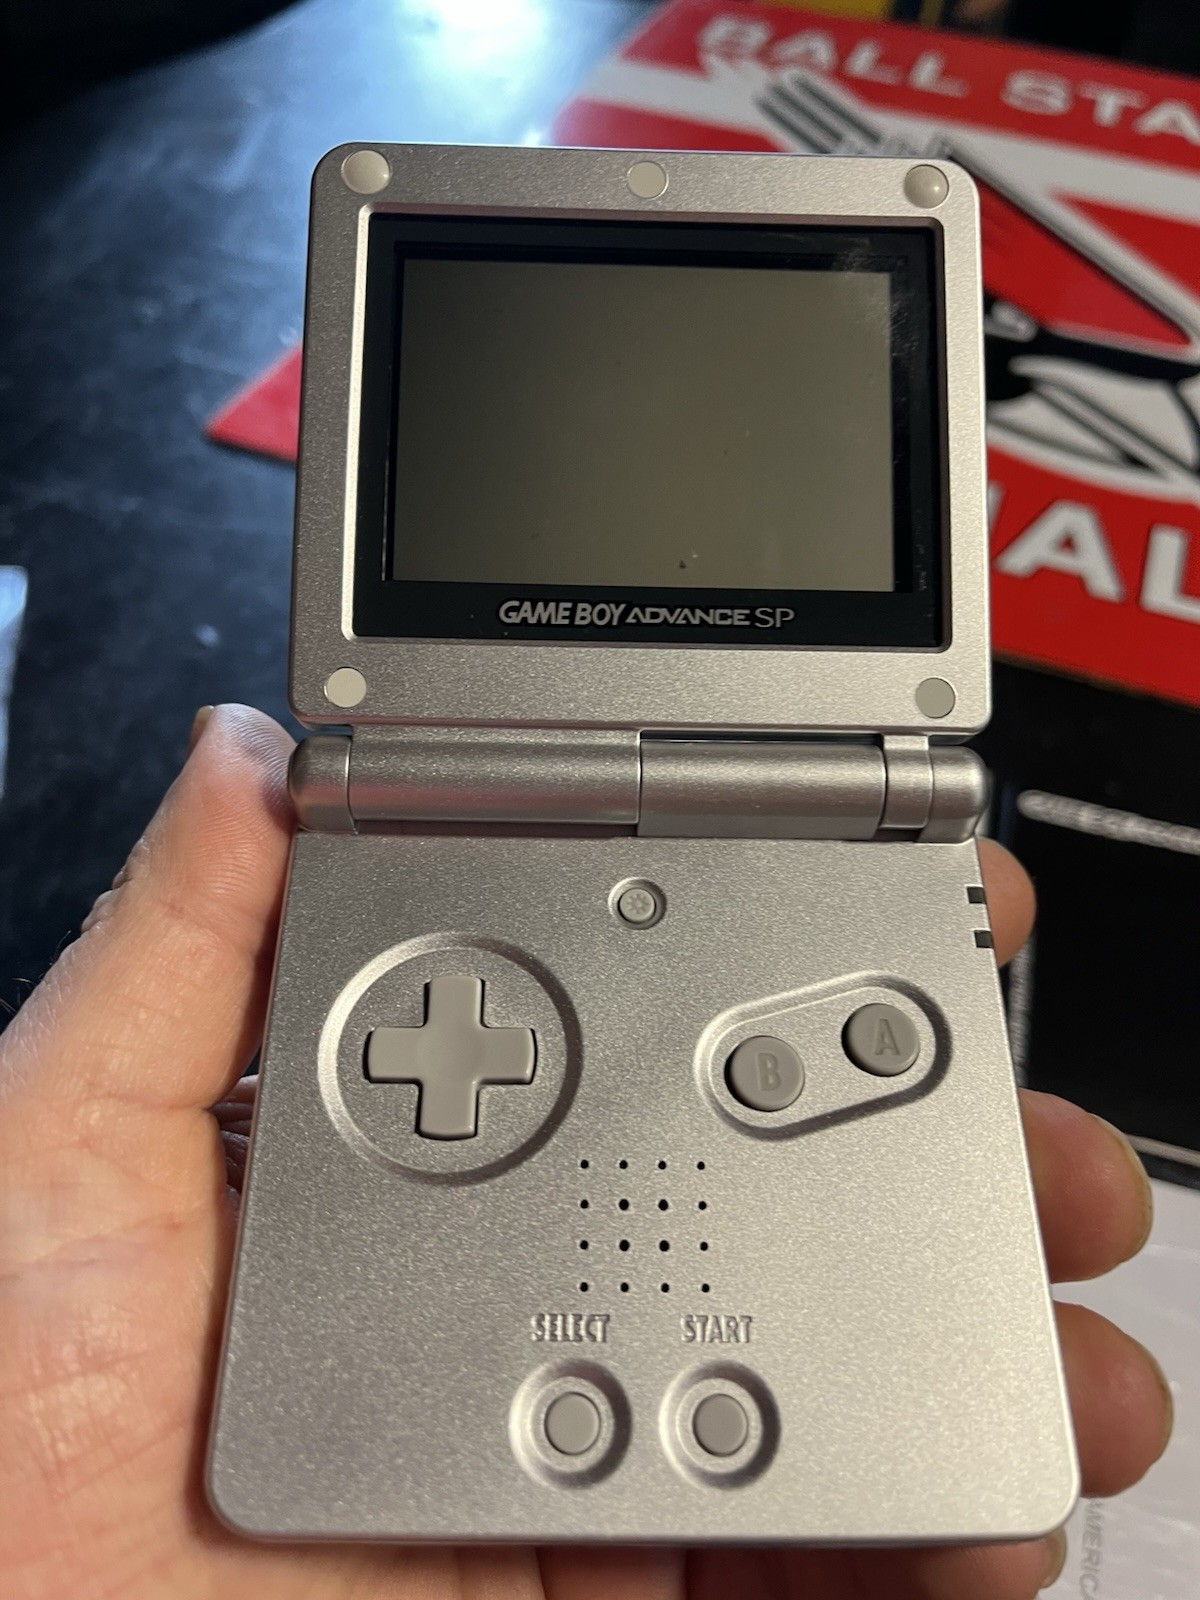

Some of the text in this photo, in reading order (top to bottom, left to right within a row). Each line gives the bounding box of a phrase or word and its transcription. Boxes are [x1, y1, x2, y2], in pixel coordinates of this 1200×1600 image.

[701, 14, 967, 98] BALL
[499, 600, 796, 628] GAME BOY ADVANCE SP
[874, 1018, 900, 1056] A
[755, 1052, 782, 1092] B
[530, 1313, 610, 1343] SELECT
[680, 1314, 752, 1343] START
